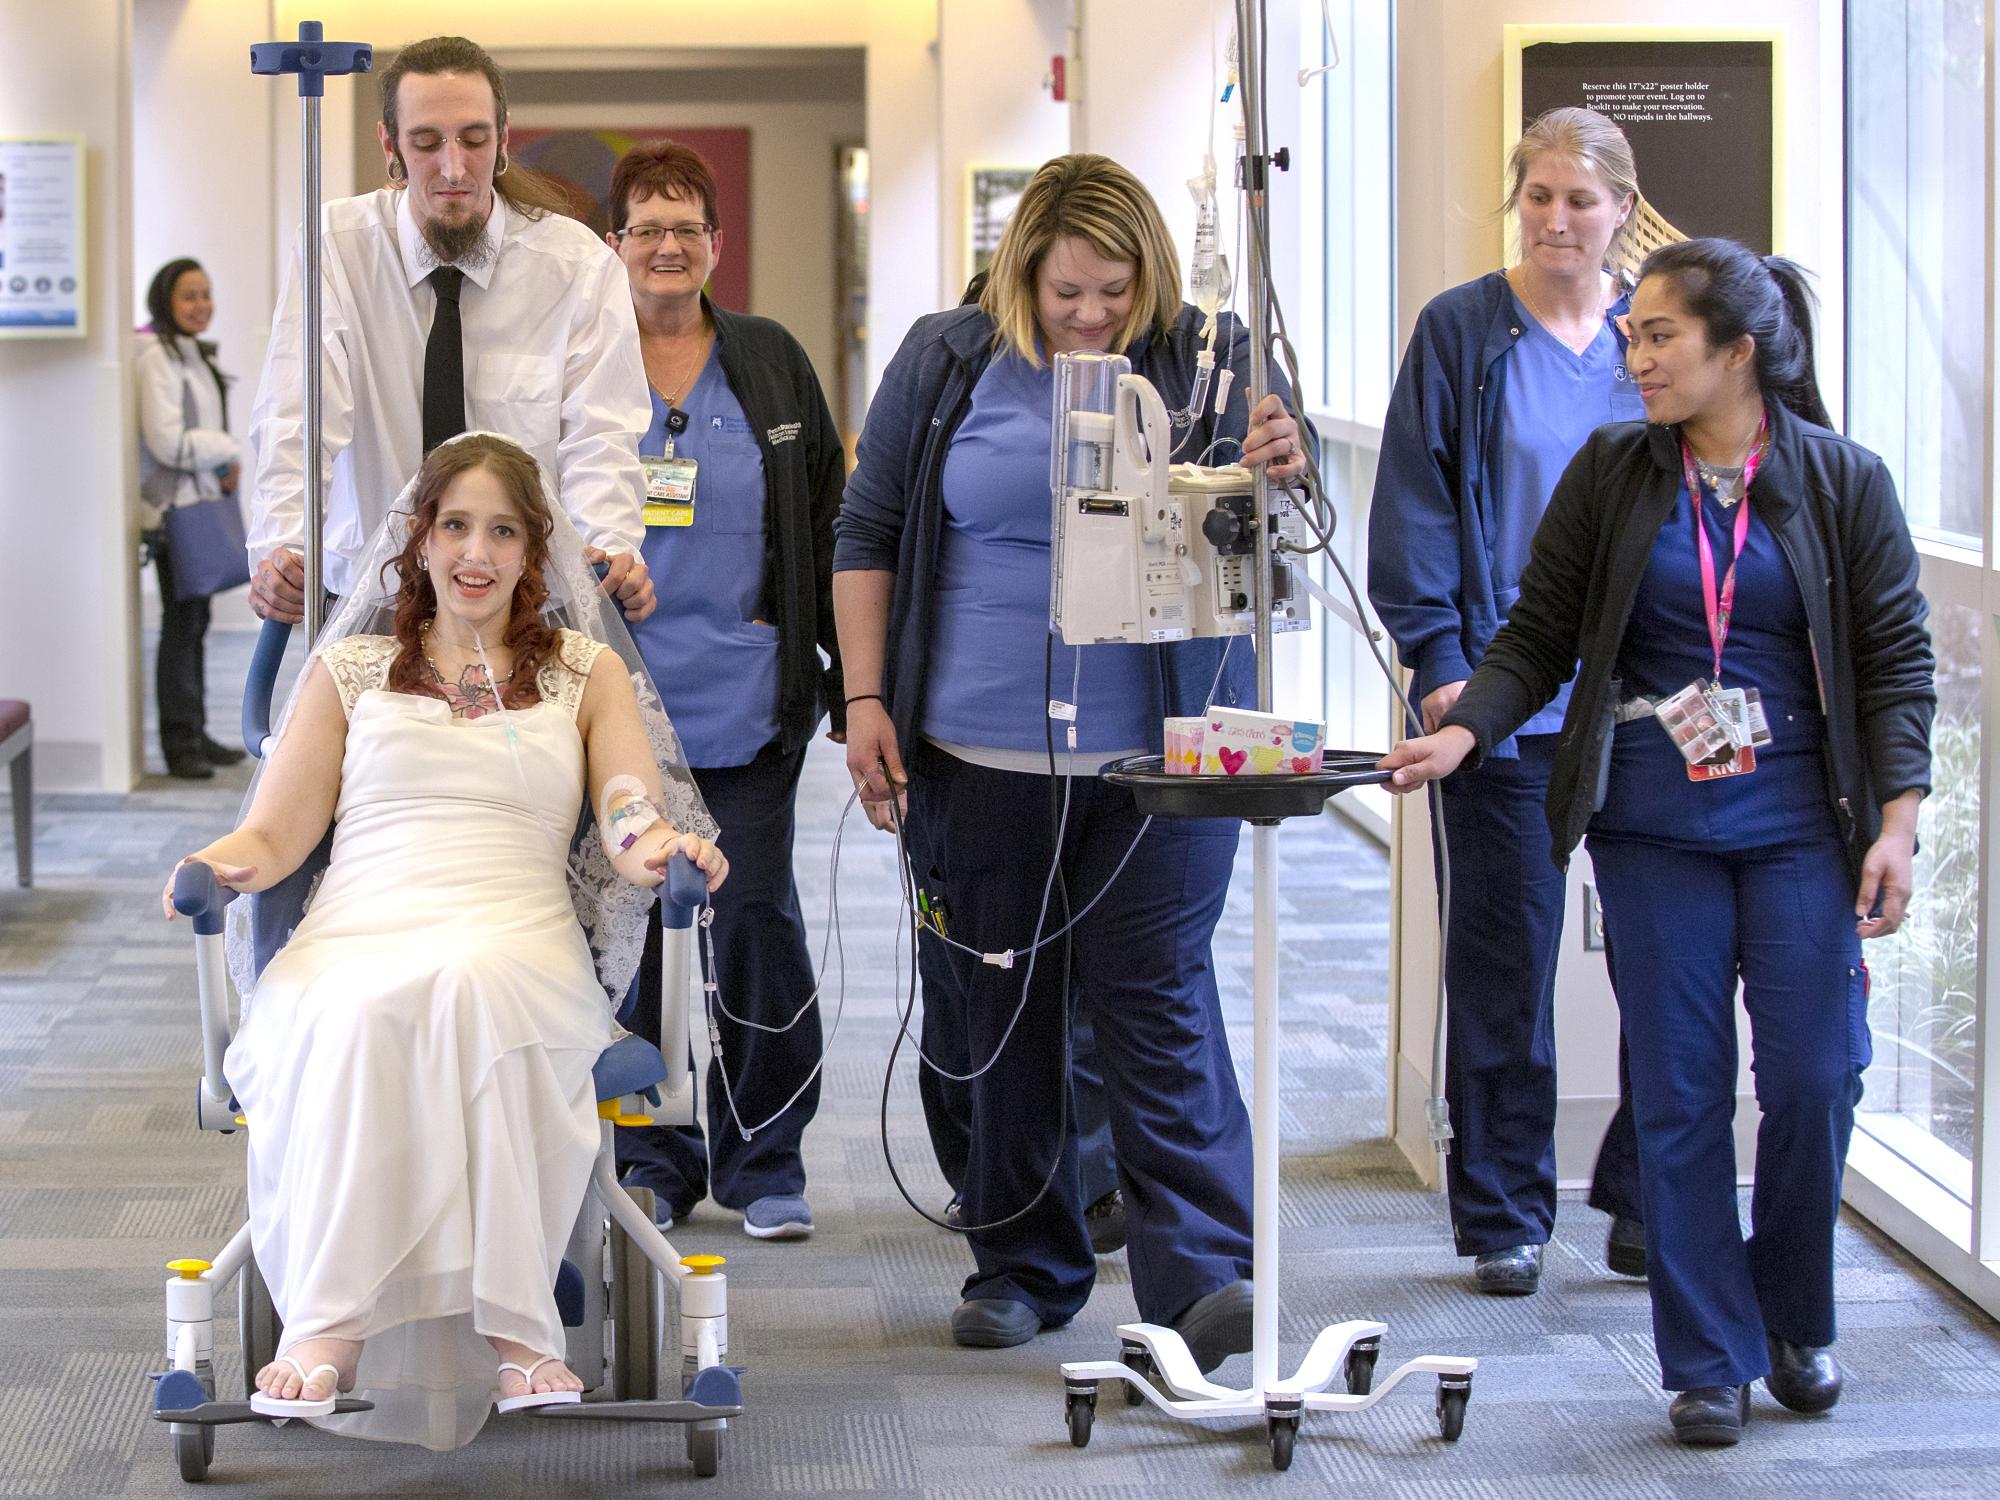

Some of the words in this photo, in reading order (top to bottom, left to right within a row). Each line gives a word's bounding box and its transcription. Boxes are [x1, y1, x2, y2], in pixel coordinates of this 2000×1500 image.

[1612, 82, 1627, 90] this
[1660, 83, 1684, 92] poster
[1685, 82, 1709, 90] holder
[1595, 94, 1626, 102] promote
[1627, 94, 1645, 102] your
[1670, 93, 1685, 102] Log
[1621, 103, 1642, 111] make
[1643, 104, 1660, 112] your
[1661, 103, 1705, 111] reservation.
[1613, 113, 1626, 121] NO
[1628, 113, 1654, 122] tripods
[1656, 113, 1664, 121] in
[1665, 113, 1677, 121] the
[1679, 113, 1713, 122] hallways.
